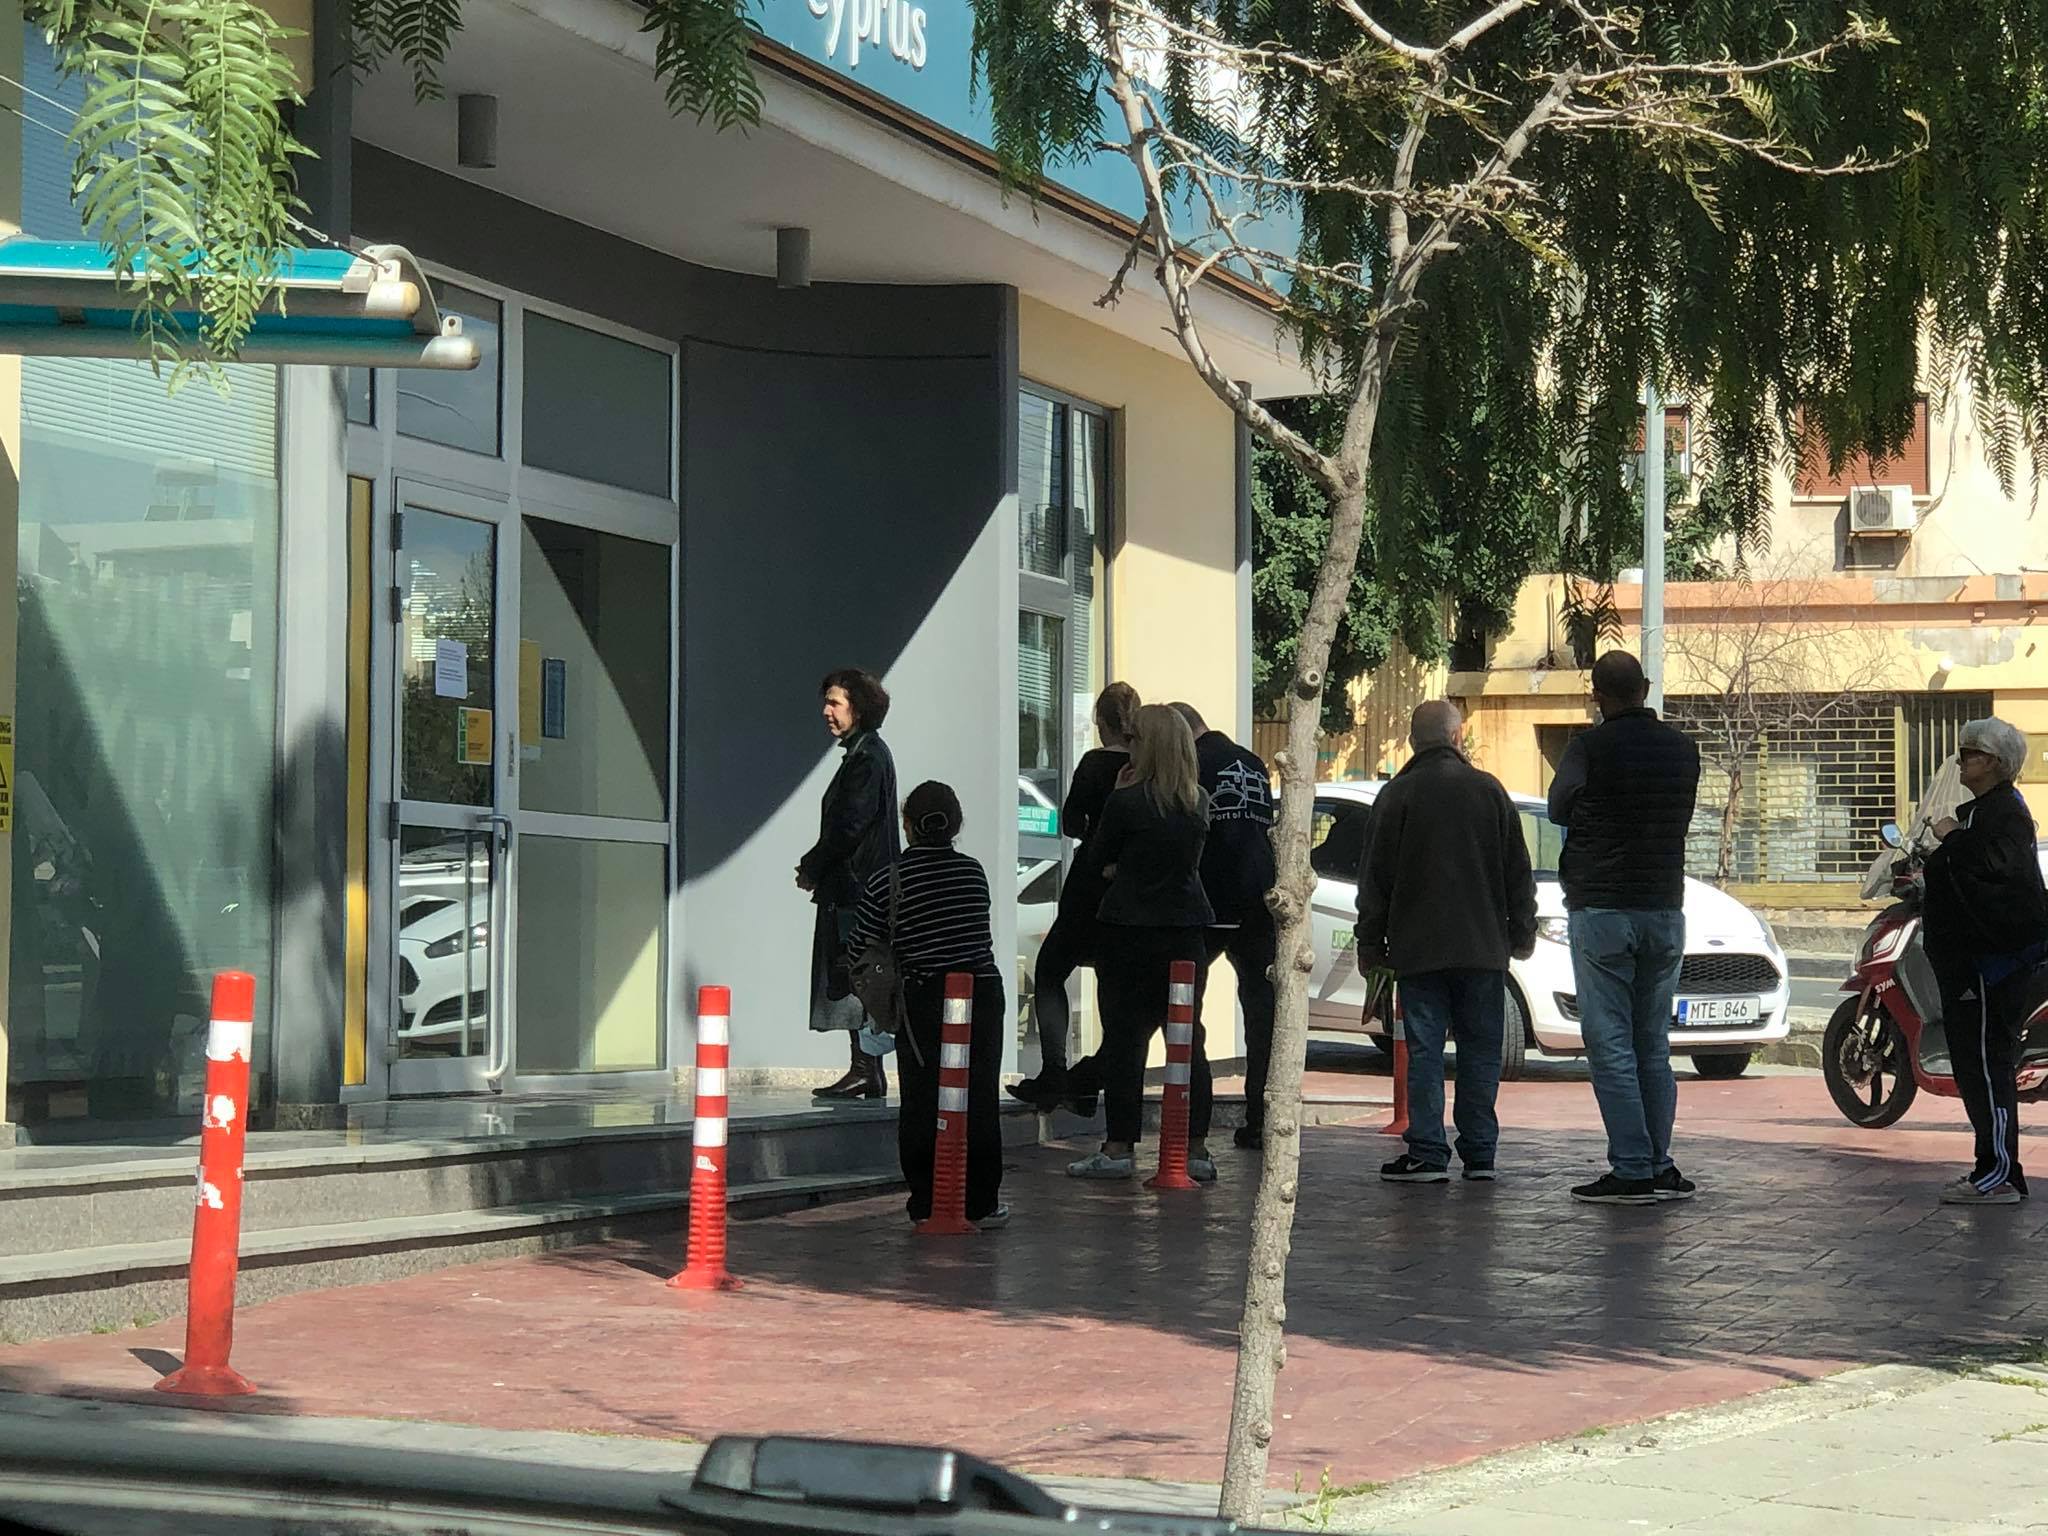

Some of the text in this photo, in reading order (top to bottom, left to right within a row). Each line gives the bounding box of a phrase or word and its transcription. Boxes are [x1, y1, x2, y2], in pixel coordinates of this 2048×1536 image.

[1874, 978, 1896, 993] SYM
[1690, 1002, 1718, 1019] MTE
[1723, 1001, 1748, 1018] 846
